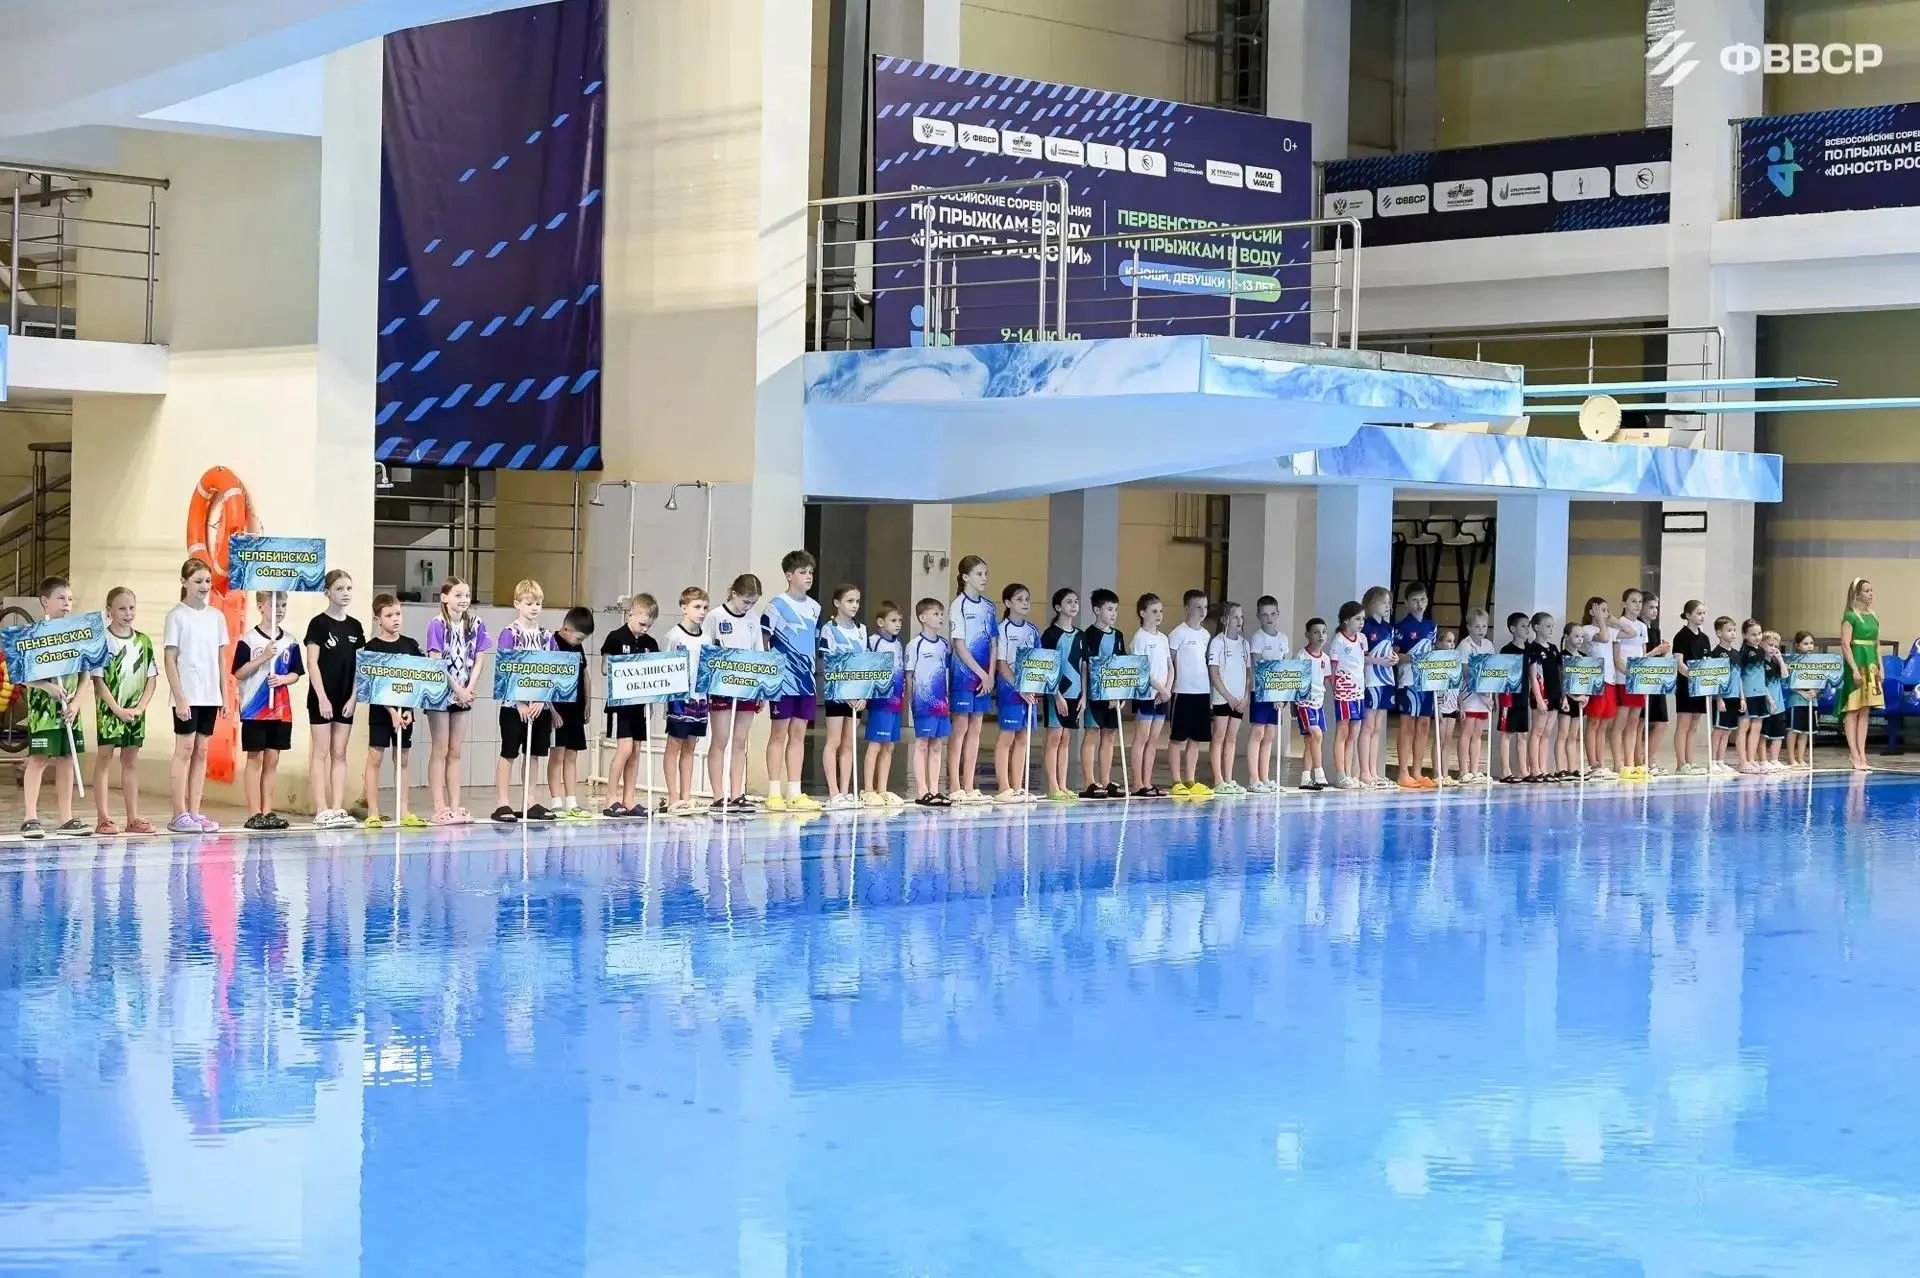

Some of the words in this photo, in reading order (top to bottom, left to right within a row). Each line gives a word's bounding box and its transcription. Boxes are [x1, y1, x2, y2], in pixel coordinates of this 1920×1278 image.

[1283, 137, 1298, 152] 0+
[1825, 133, 1894, 147] ВСЕРОССИЙСКИЕ
[1824, 149, 1842, 161] ПО
[1845, 142, 1911, 159] ПРЫЖКАМ
[1255, 170, 1274, 180] MAD
[1824, 160, 1892, 177] «ЮНОСТЬ
[1253, 179, 1275, 189] WAVE
[1395, 195, 1426, 205] ФВВСР
[911, 203, 936, 223] ПО
[939, 207, 1028, 233] ПРЫЖКАМ
[1144, 237, 1224, 260] ПРЫЖКАМ
[1240, 248, 1281, 266] ВОДУ
[1173, 273, 1225, 289] ДЕВУШКИ
[237, 550, 318, 563] ЧЕЛЯБИНСКАЯ
[256, 566, 298, 577] область
[16, 628, 93, 652] ПЕНЗЕНСКАЯ
[35, 649, 80, 664] область
[360, 665, 445, 682] СТАВРОПОЛЬСКИЙ
[499, 660, 576, 676] СВЕРДЛОВСКАЯ
[613, 663, 685, 678] САХАЛИНСКАЯ
[707, 659, 777, 675] САРАТОВСКАЯ
[1101, 667, 1139, 678] Республика
[722, 675, 759, 686] область
[825, 671, 892, 681] САНКТ-ПЕТЕРБУРГ
[1265, 670, 1302, 680] Республика
[392, 683, 413, 694] край
[517, 676, 554, 689] область
[626, 679, 671, 691] ОБЛАСТЬ
[1264, 681, 1302, 690] МОРДОВИЯ
